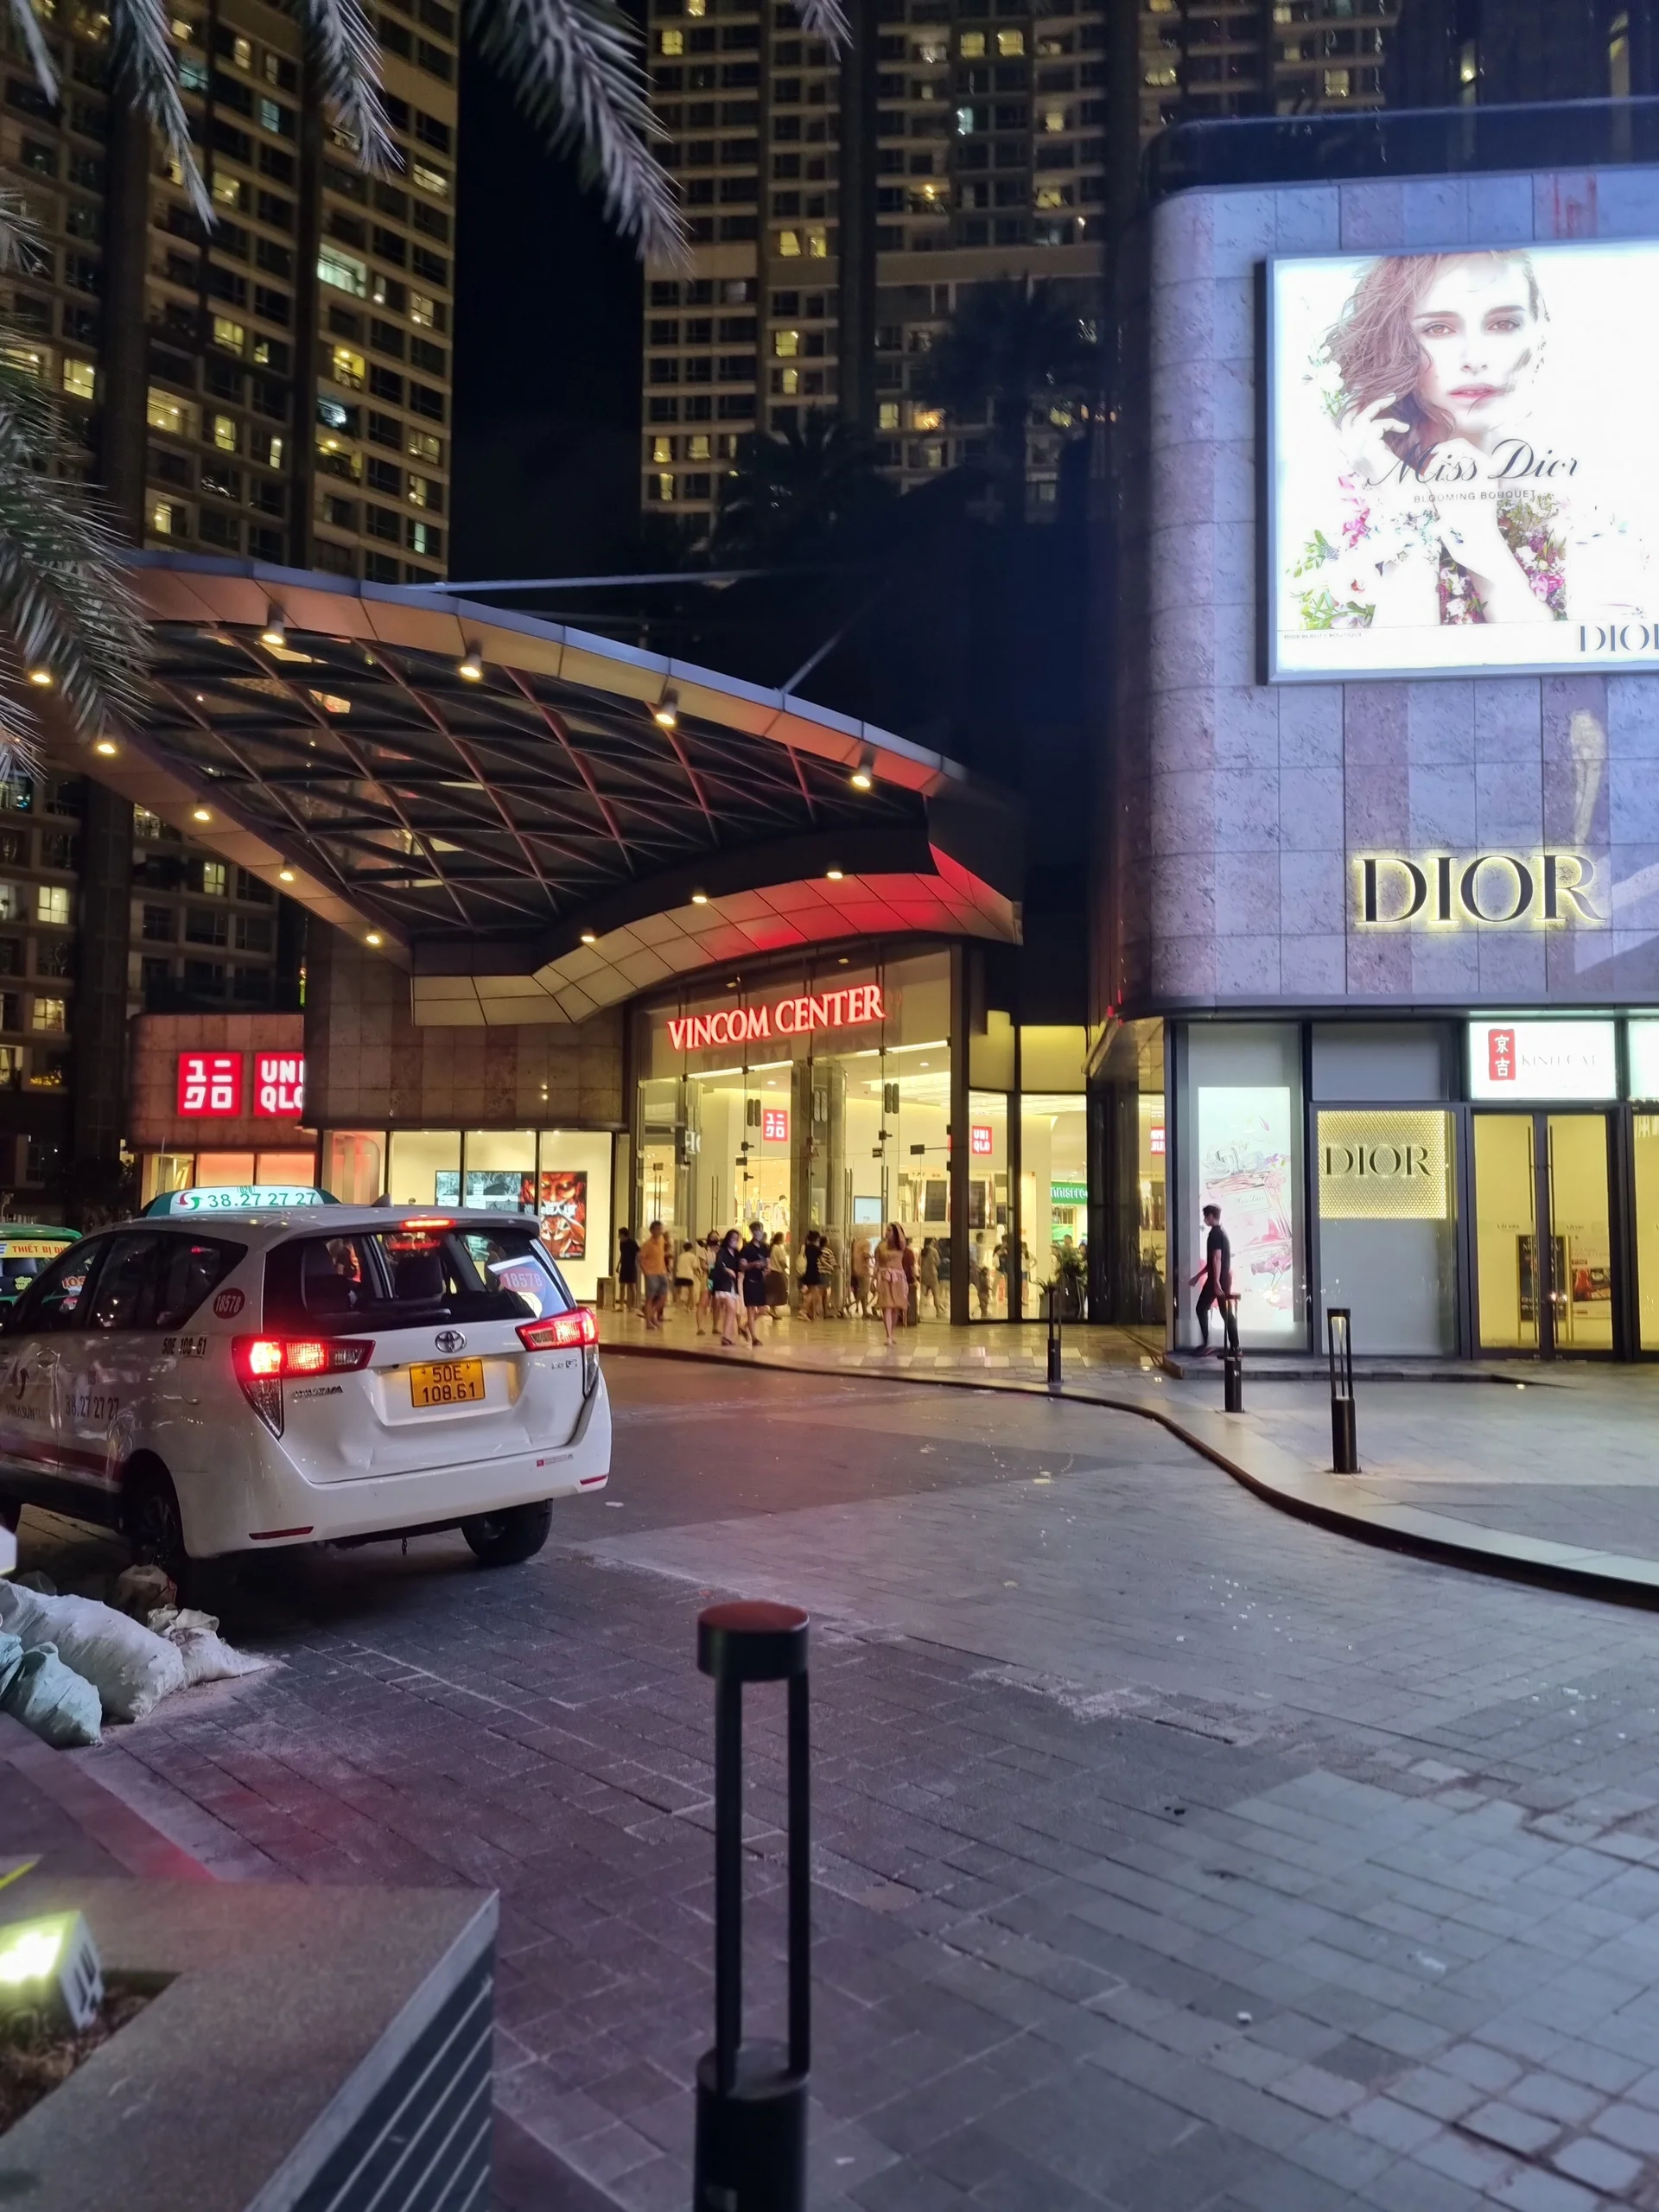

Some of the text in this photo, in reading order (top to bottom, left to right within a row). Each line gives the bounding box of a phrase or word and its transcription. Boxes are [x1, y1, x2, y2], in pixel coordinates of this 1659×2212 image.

[1366, 438, 1578, 486] Miss Dior
[1414, 489, 1536, 504] BLOOMING BOUQUET
[1354, 854, 1606, 924] DIOR
[667, 984, 887, 1051] VINCOM CENTER
[973, 1129, 989, 1140] UNI
[973, 1141, 990, 1152] QLO
[1324, 1143, 1433, 1177] DIOR
[207, 1192, 316, 1208] 38.27 27 27
[504, 1272, 543, 1287] 18578
[214, 1294, 242, 1314] 18578
[432, 1363, 462, 1383] 50E
[422, 1382, 477, 1403] 108.61
[93, 1396, 105, 1420] 27
[107, 1397, 119, 1421] 27
